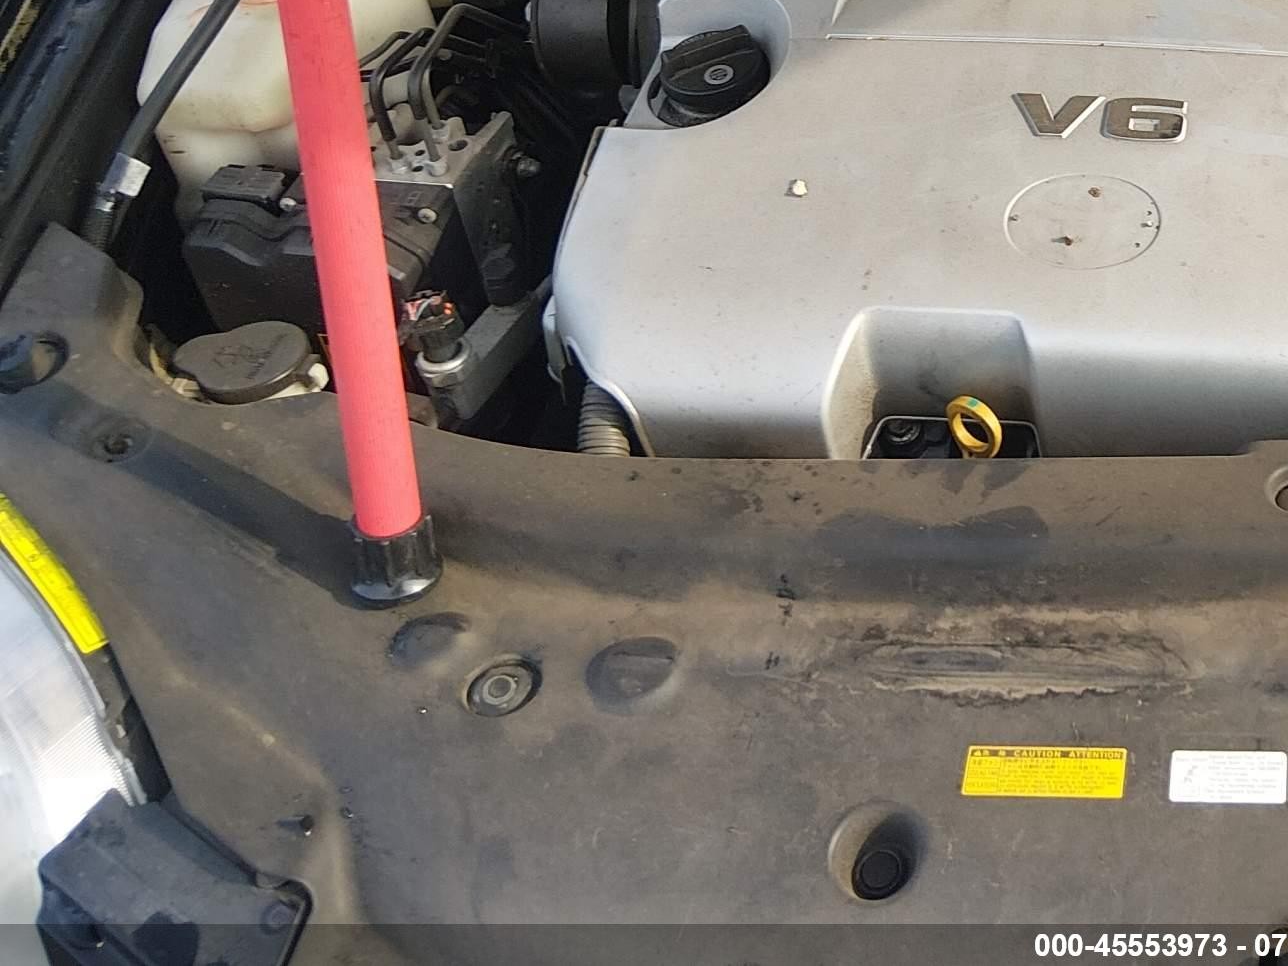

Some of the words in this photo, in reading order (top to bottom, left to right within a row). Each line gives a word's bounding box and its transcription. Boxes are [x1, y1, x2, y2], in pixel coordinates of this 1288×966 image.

[1011, 92, 1188, 143] V6
[1013, 749, 1061, 759] CAUTION
[1068, 750, 1122, 760] ATTENTION
